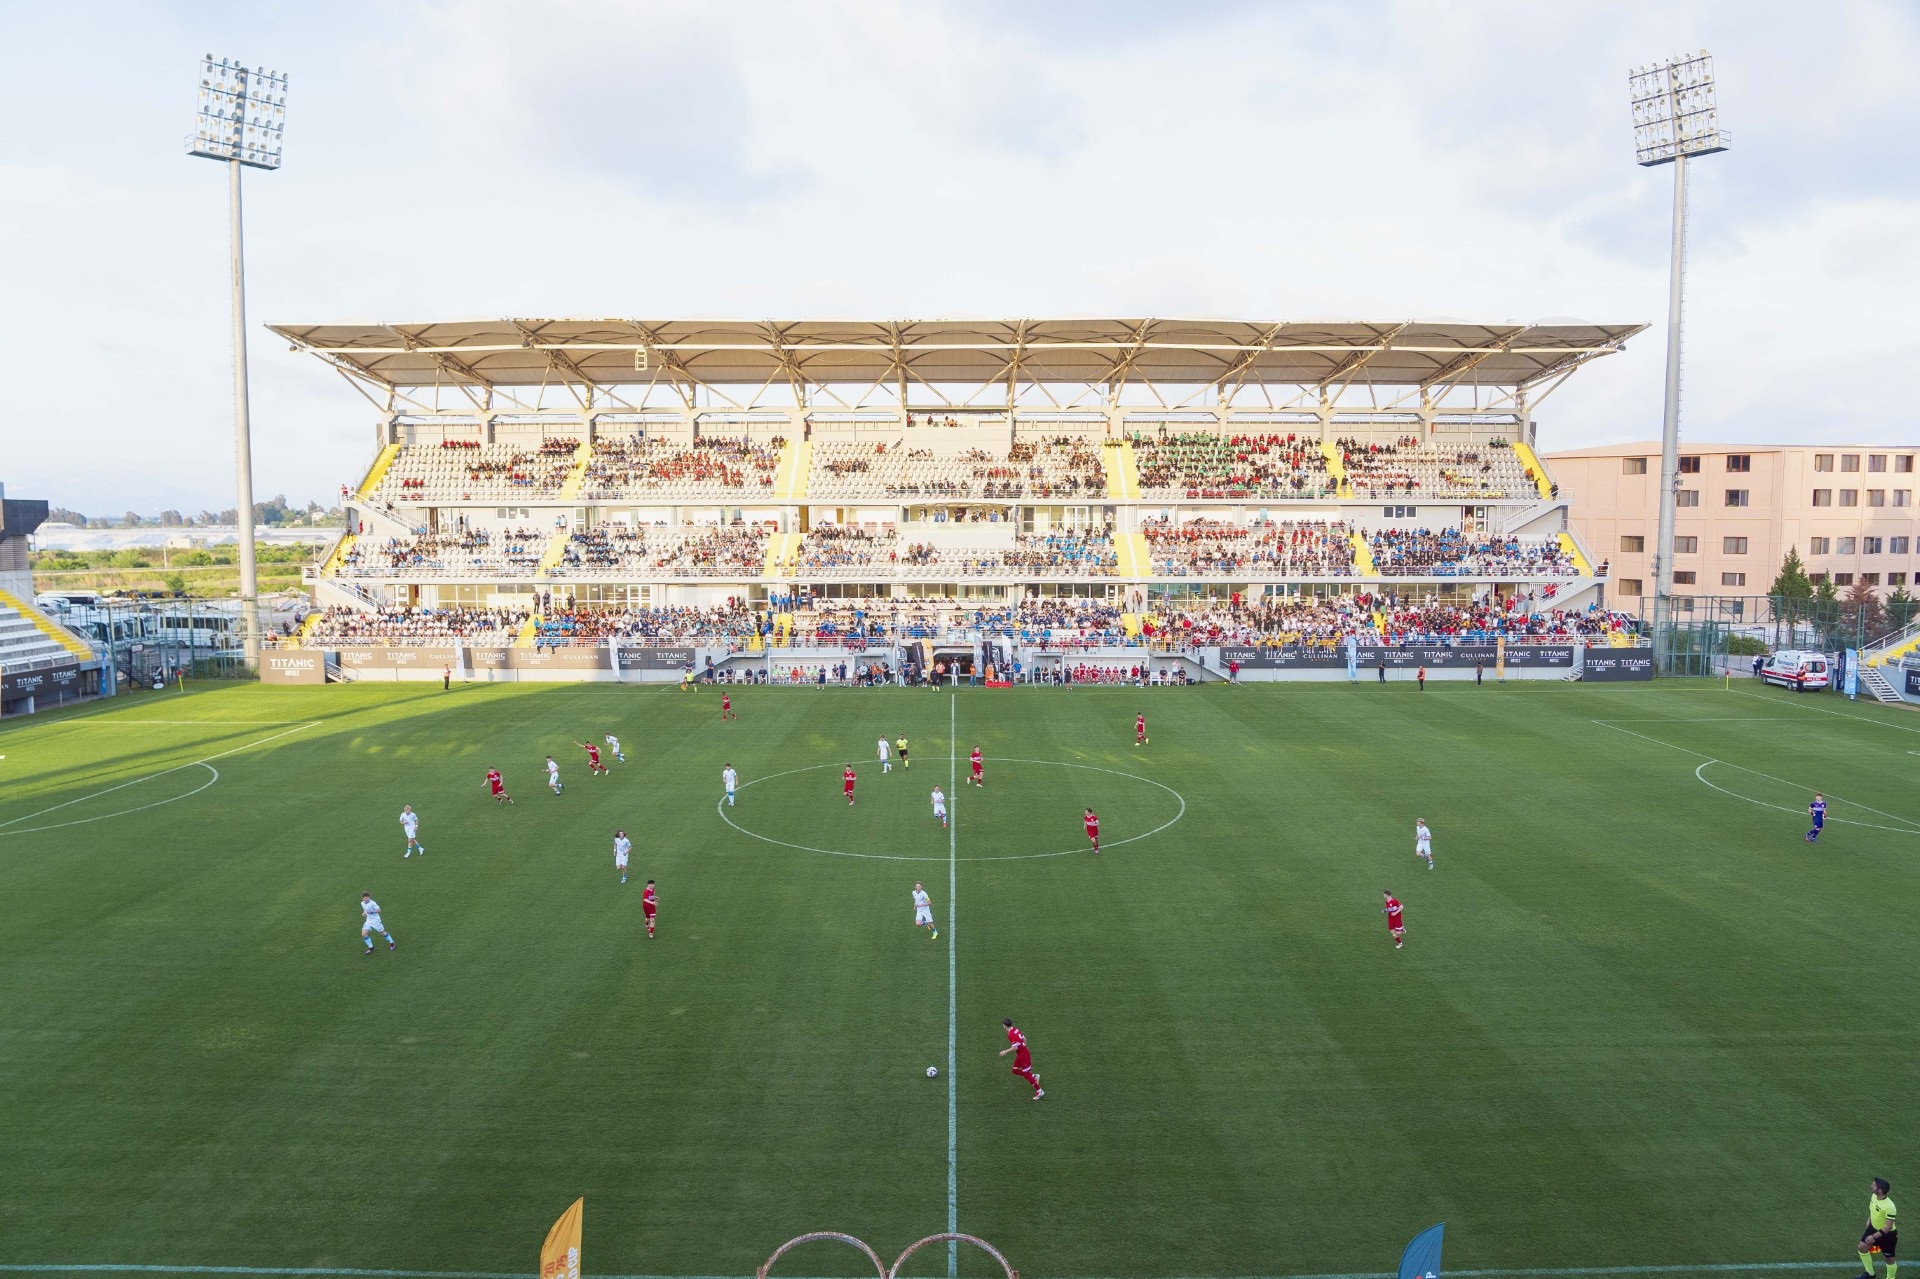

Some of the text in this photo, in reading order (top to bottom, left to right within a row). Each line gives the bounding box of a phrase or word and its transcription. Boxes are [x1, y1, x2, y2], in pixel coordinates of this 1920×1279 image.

[270, 657, 315, 668] TITANIC
[1620, 658, 1651, 666] TITANIC
[52, 669, 77, 680] TITANIC
[16, 675, 43, 686] TITANIC
